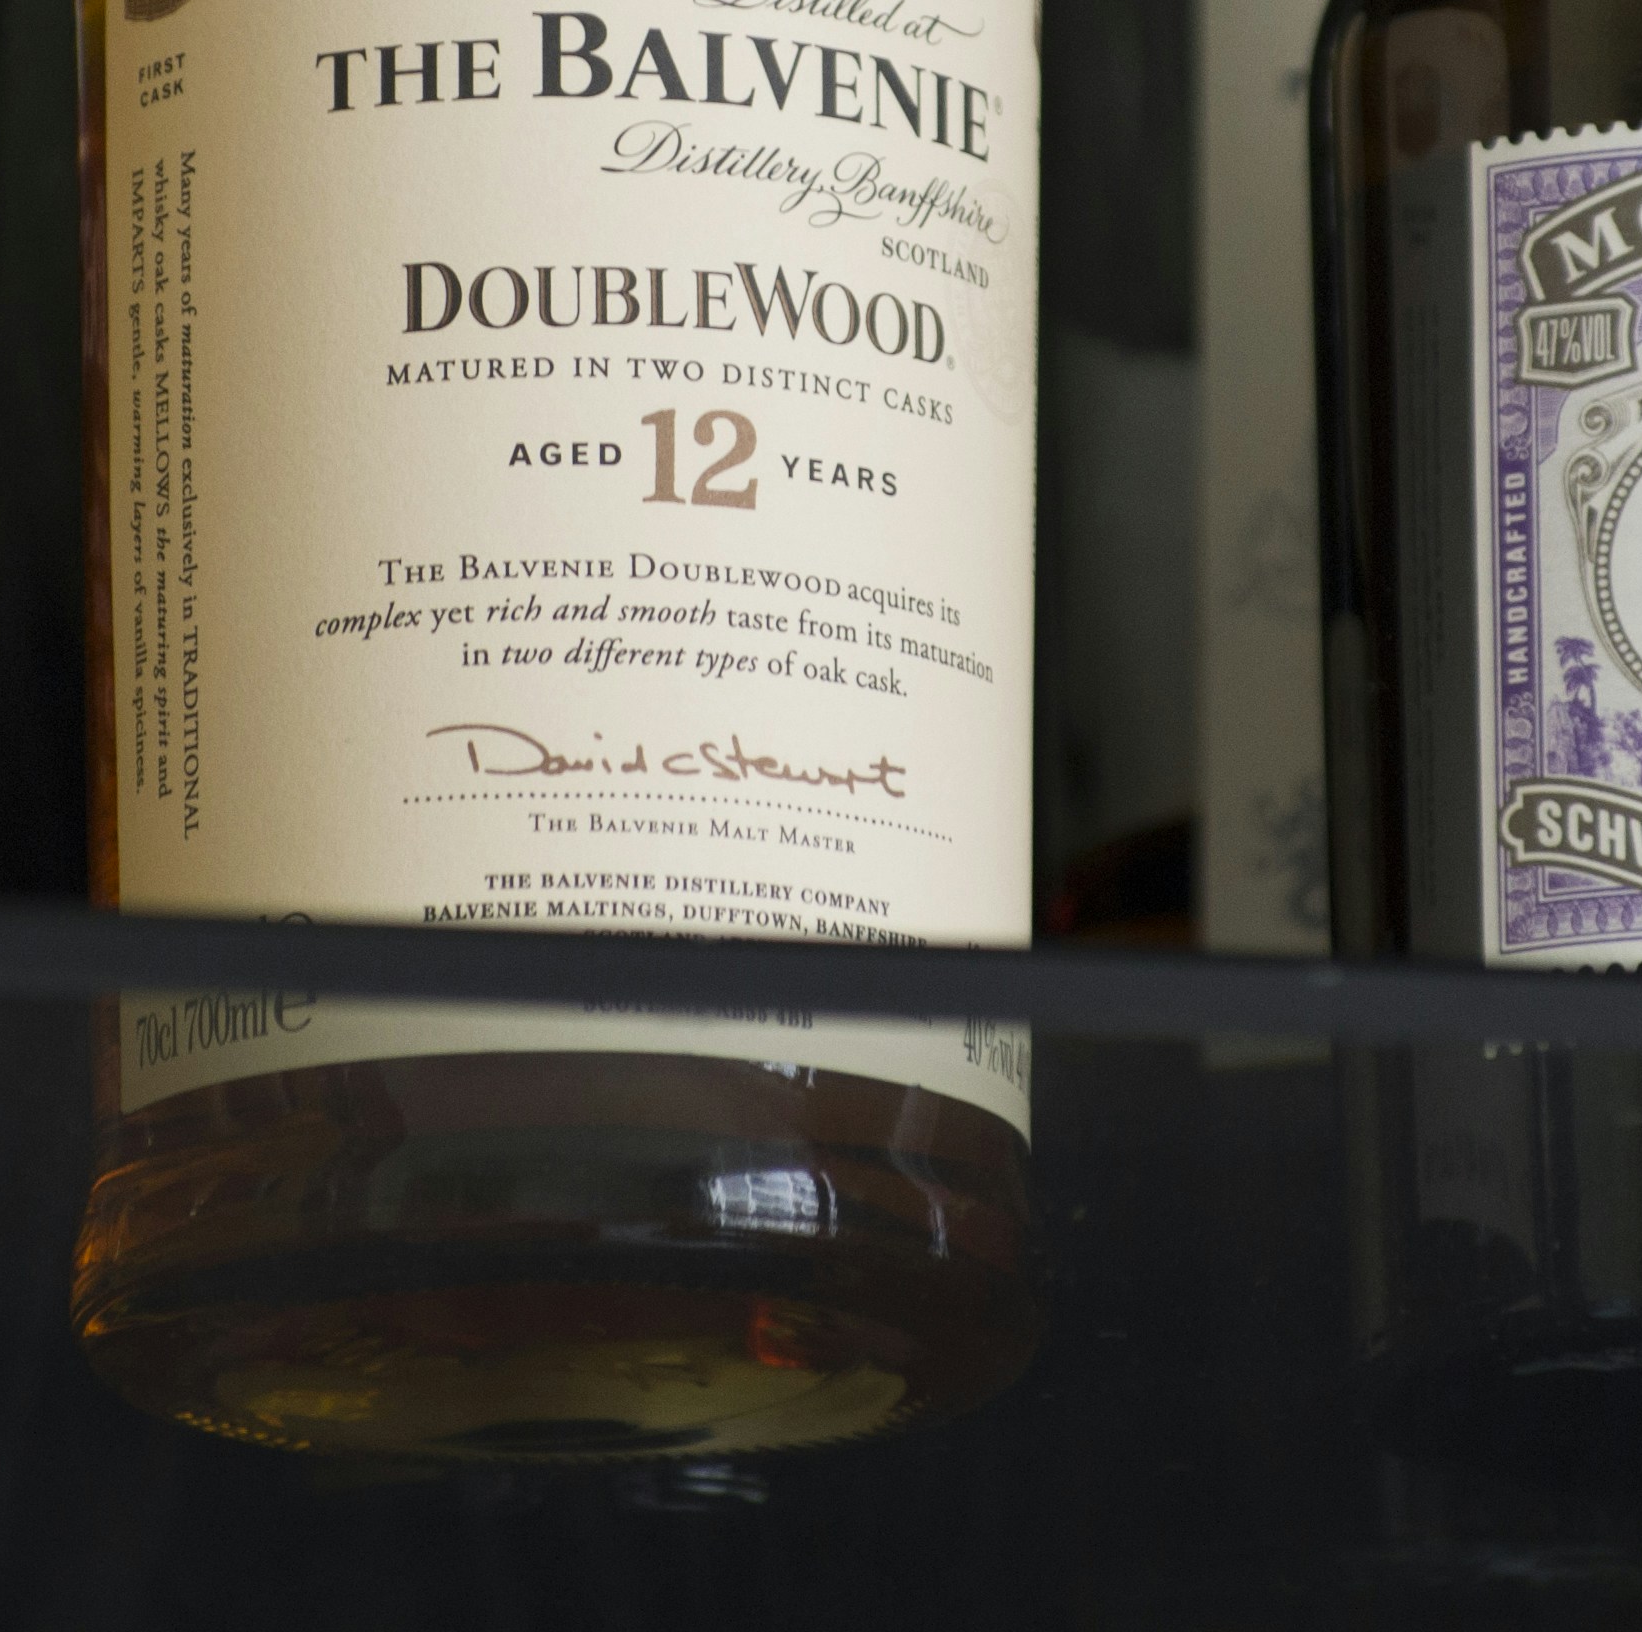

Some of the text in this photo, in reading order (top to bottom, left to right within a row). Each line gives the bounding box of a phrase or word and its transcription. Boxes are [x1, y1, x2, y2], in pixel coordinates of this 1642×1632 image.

[903, 14, 985, 46] at
[138, 52, 186, 84] FIRST
[140, 79, 184, 108] CASK
[316, 10, 991, 163] THE BALVENIE
[601, 120, 1010, 244] Distillery, Banffshire
[880, 236, 989, 290] SCOTLAND
[386, 356, 955, 426] MATURED IN TWO DISTINCT CASKS
[128, 166, 148, 795] IMPARTS gentle, warming layers of vanilla spiciness.
[151, 158, 172, 799] whisky oak casks MELLOWS the maturing spirit and
[175, 150, 201, 840] Many years of maturation exclusively in TRADITIONAL
[508, 408, 900, 511] AGED 12 YEARS
[460, 554, 615, 581] BALVENIE
[847, 584, 936, 620] acquires
[941, 596, 962, 626] its
[1505, 470, 1530, 686] HANDCRAFTED
[315, 594, 994, 684] complex yet rich and smooth taste from its maturation
[461, 641, 909, 699] in two different types of oak cask.
[425, 723, 645, 776] David
[698, 734, 906, 799] Stewart
[528, 813, 857, 856] THE BALVENIE MALT MASTER
[422, 900, 538, 924] BALVENIE
[546, 898, 674, 924] MALTINGS,
[682, 902, 809, 939] DUFFTOWN,
[484, 872, 892, 918] THE BALVENIE DISTILLERY COMPANY
[136, 1004, 178, 1069] 70cl
[184, 986, 269, 1055] 700ml
